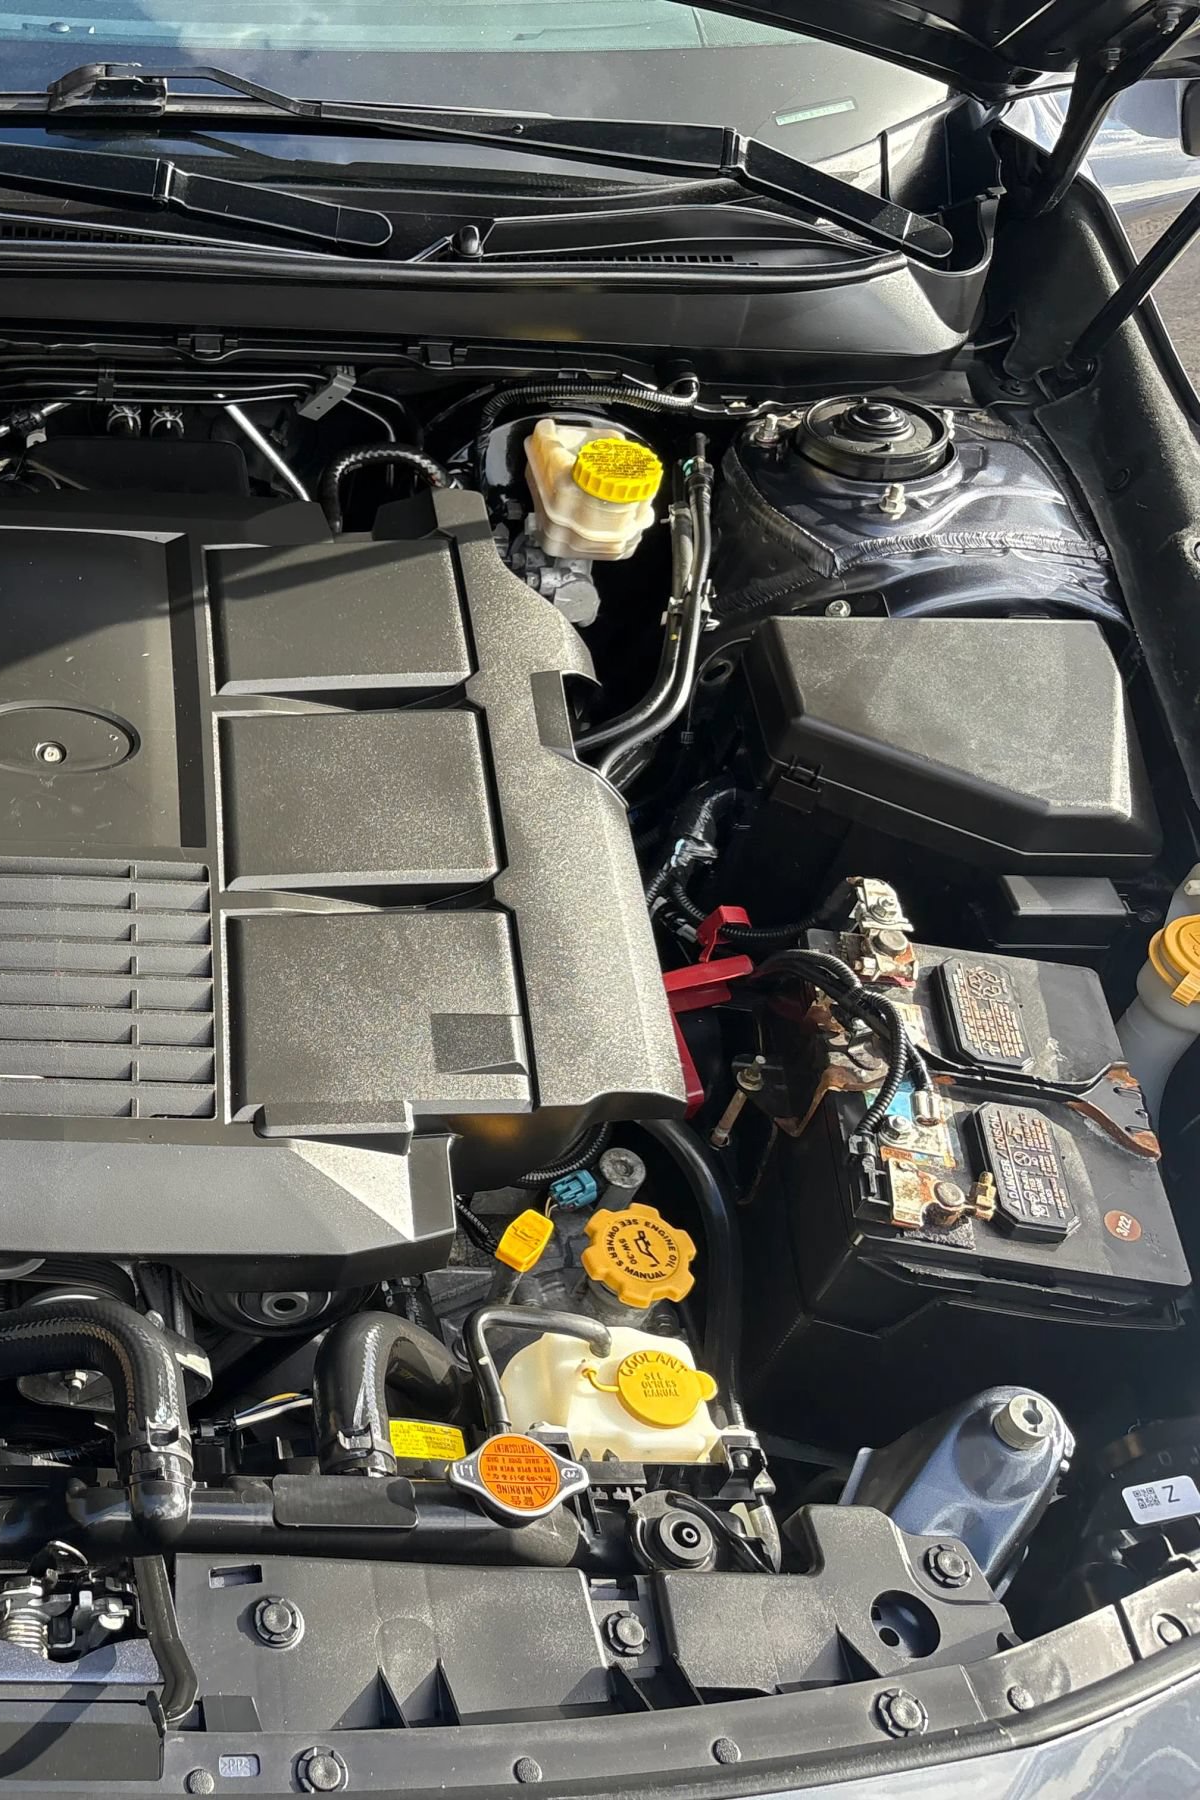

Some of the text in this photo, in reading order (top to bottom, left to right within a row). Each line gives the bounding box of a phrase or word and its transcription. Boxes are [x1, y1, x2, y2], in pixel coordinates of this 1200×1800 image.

[988, 1113, 1008, 1151] POISON
[1000, 1159, 1020, 1200] DANGER
[1115, 1215, 1132, 1237] 3/22
[606, 1218, 667, 1279] SEE OWNER'S MANUAL
[618, 1238, 638, 1265] 5W-30
[644, 1221, 677, 1268] ENGINE OIL
[620, 1352, 688, 1377] COOLANT
[496, 1483, 533, 1495] WARNING
[1161, 1484, 1181, 1503] Z
